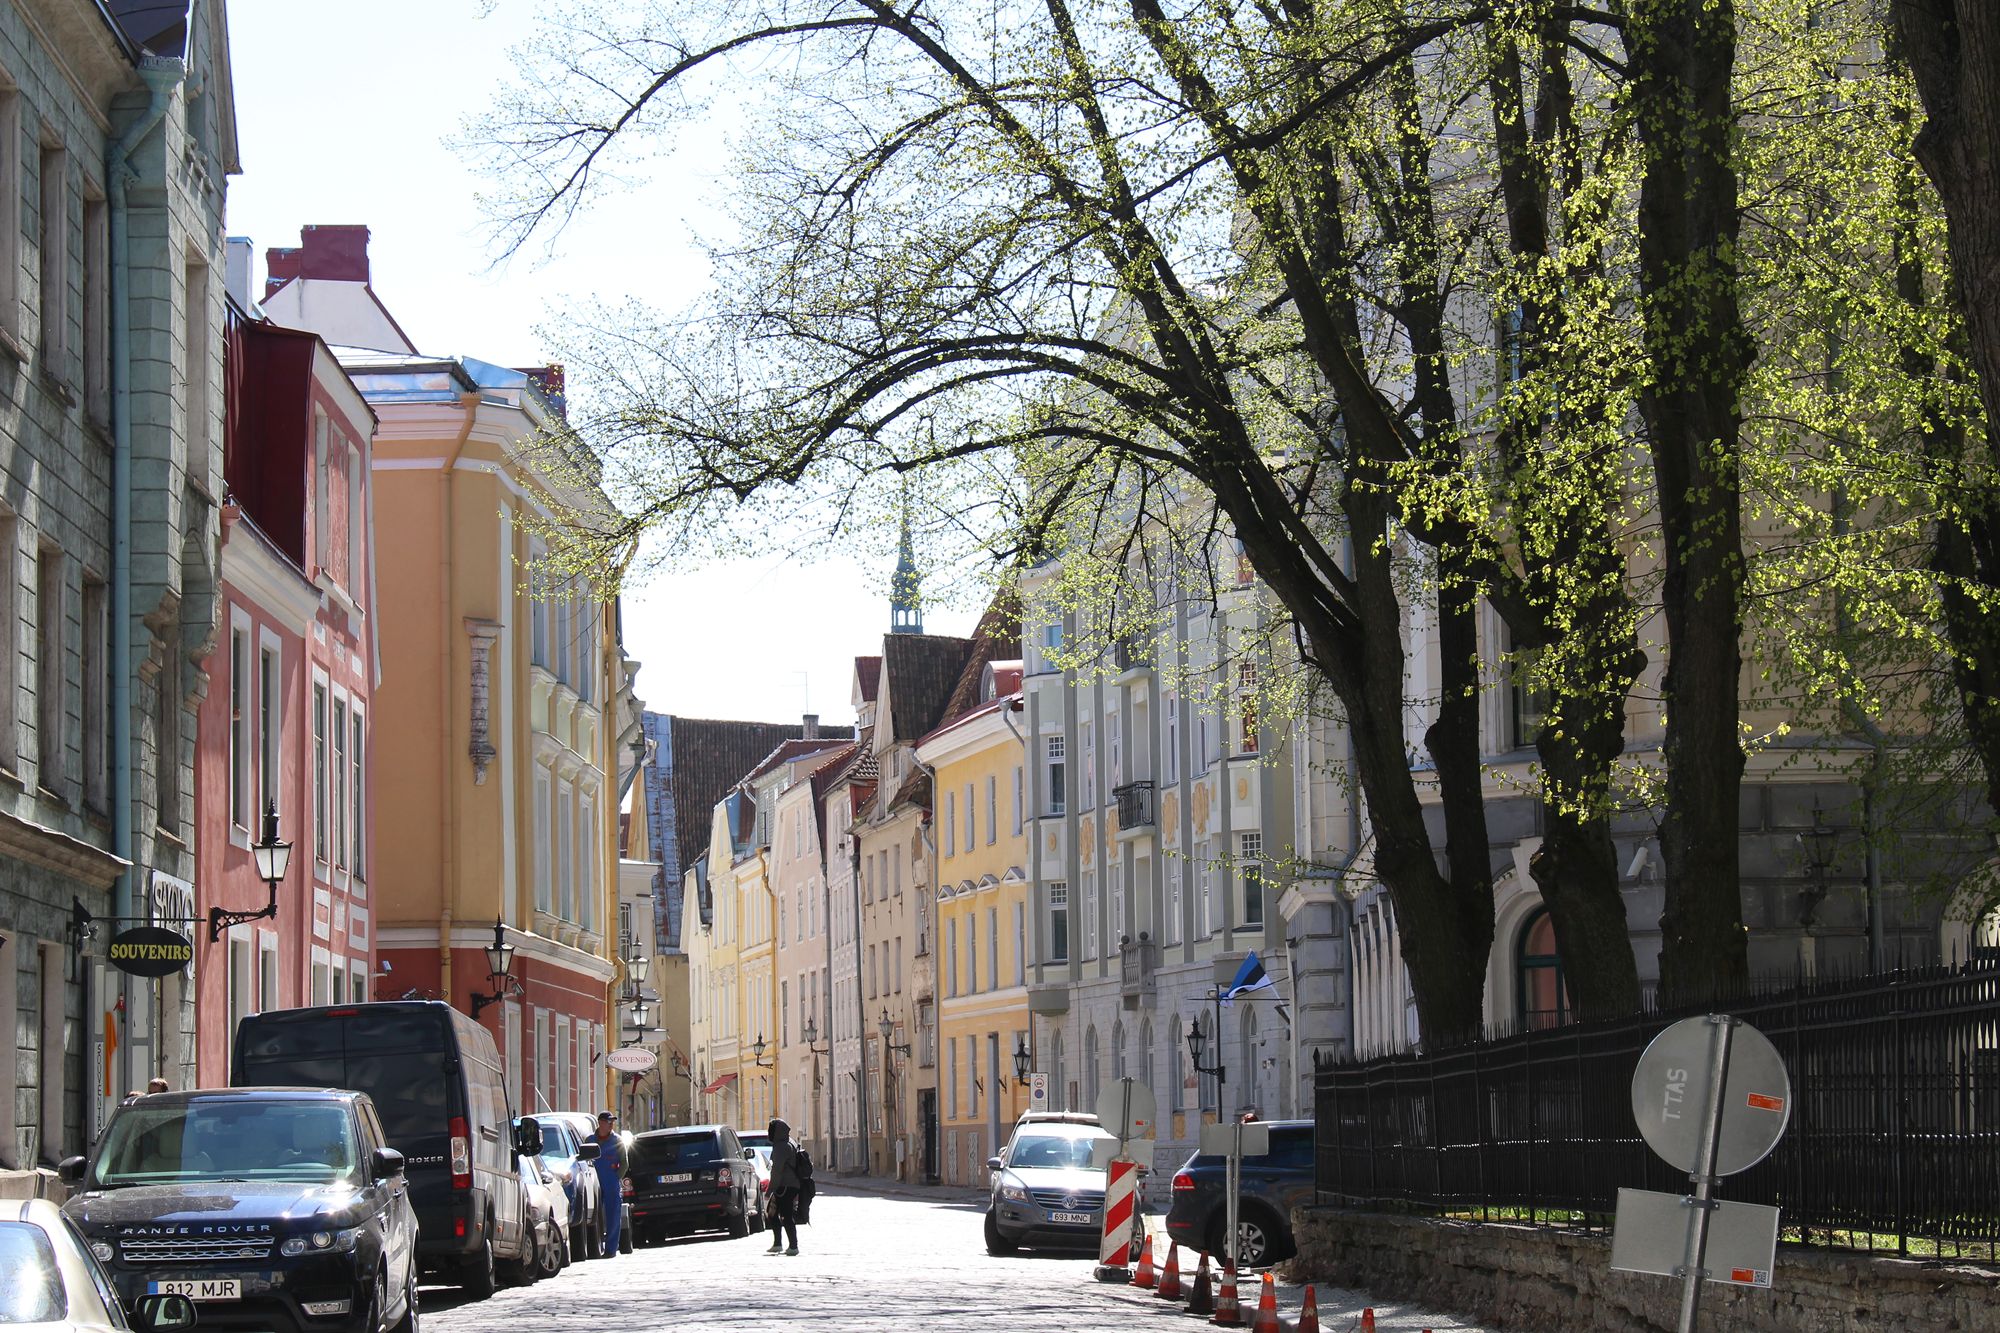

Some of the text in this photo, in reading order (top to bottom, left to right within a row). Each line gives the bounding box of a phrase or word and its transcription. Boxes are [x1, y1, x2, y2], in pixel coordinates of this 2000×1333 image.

[110, 944, 191, 960] SOUVENIRS
[610, 1055, 653, 1063] SOUVENIRS
[408, 1156, 444, 1164] BOXER
[1054, 1213, 1068, 1221] 693
[203, 1224, 270, 1233] ROVER
[166, 1282, 235, 1297] 812 MJR
